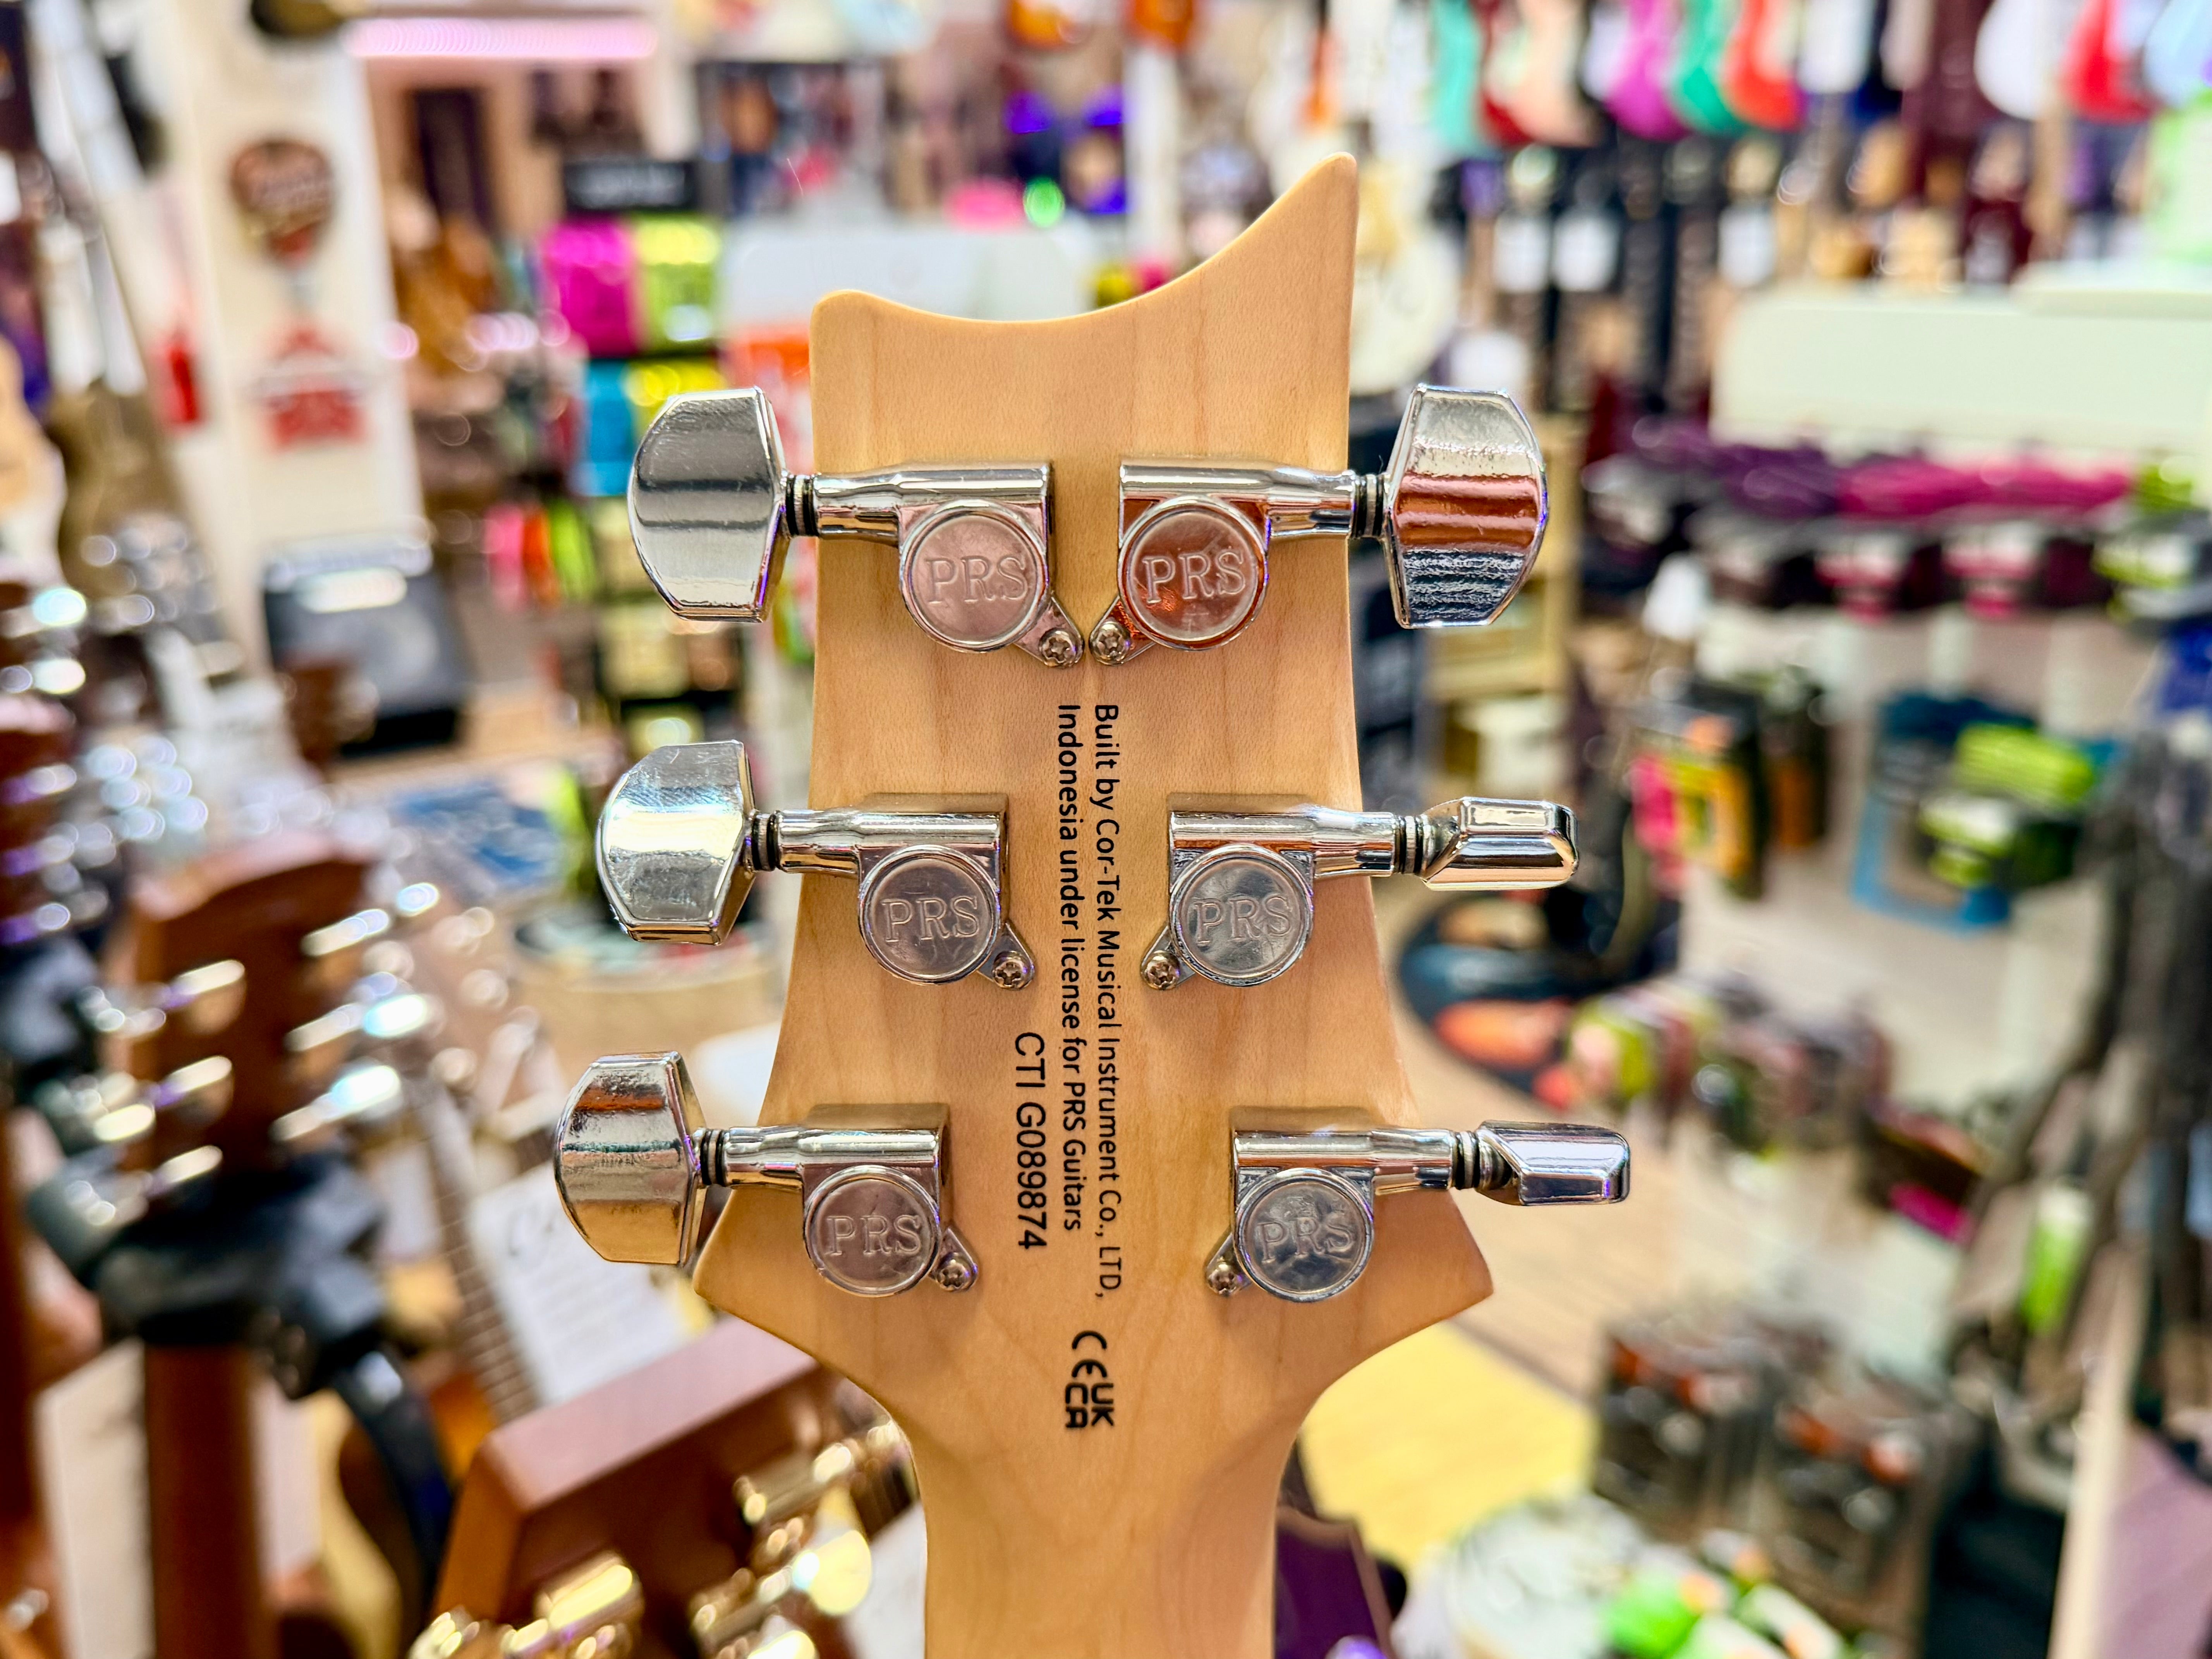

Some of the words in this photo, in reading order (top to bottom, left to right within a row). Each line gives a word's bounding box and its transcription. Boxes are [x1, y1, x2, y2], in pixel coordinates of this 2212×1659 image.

[925, 554, 1028, 605] PRS
[1142, 550, 1247, 605] PRS
[1094, 704, 1121, 770] Built
[1057, 704, 1084, 840] Indonesia
[1089, 778, 1121, 811] by
[1059, 849, 1086, 931] under
[1096, 818, 1122, 922] Cor-Tek
[880, 895, 979, 943] PRS
[1193, 893, 1293, 947] PRS
[1060, 938, 1086, 1029] license
[1096, 930, 1123, 1029] Musical
[1014, 1031, 1046, 1088] CTI
[1062, 1036, 1088, 1074] for
[1063, 1082, 1087, 1132] PRS
[1098, 1038, 1121, 1182] Instrument
[1015, 1101, 1048, 1250] G089874
[1062, 1139, 1087, 1231] Guitars
[826, 1213, 923, 1257] PRS
[1094, 1189, 1122, 1237] Co.,
[1255, 1214, 1355, 1264] PRS
